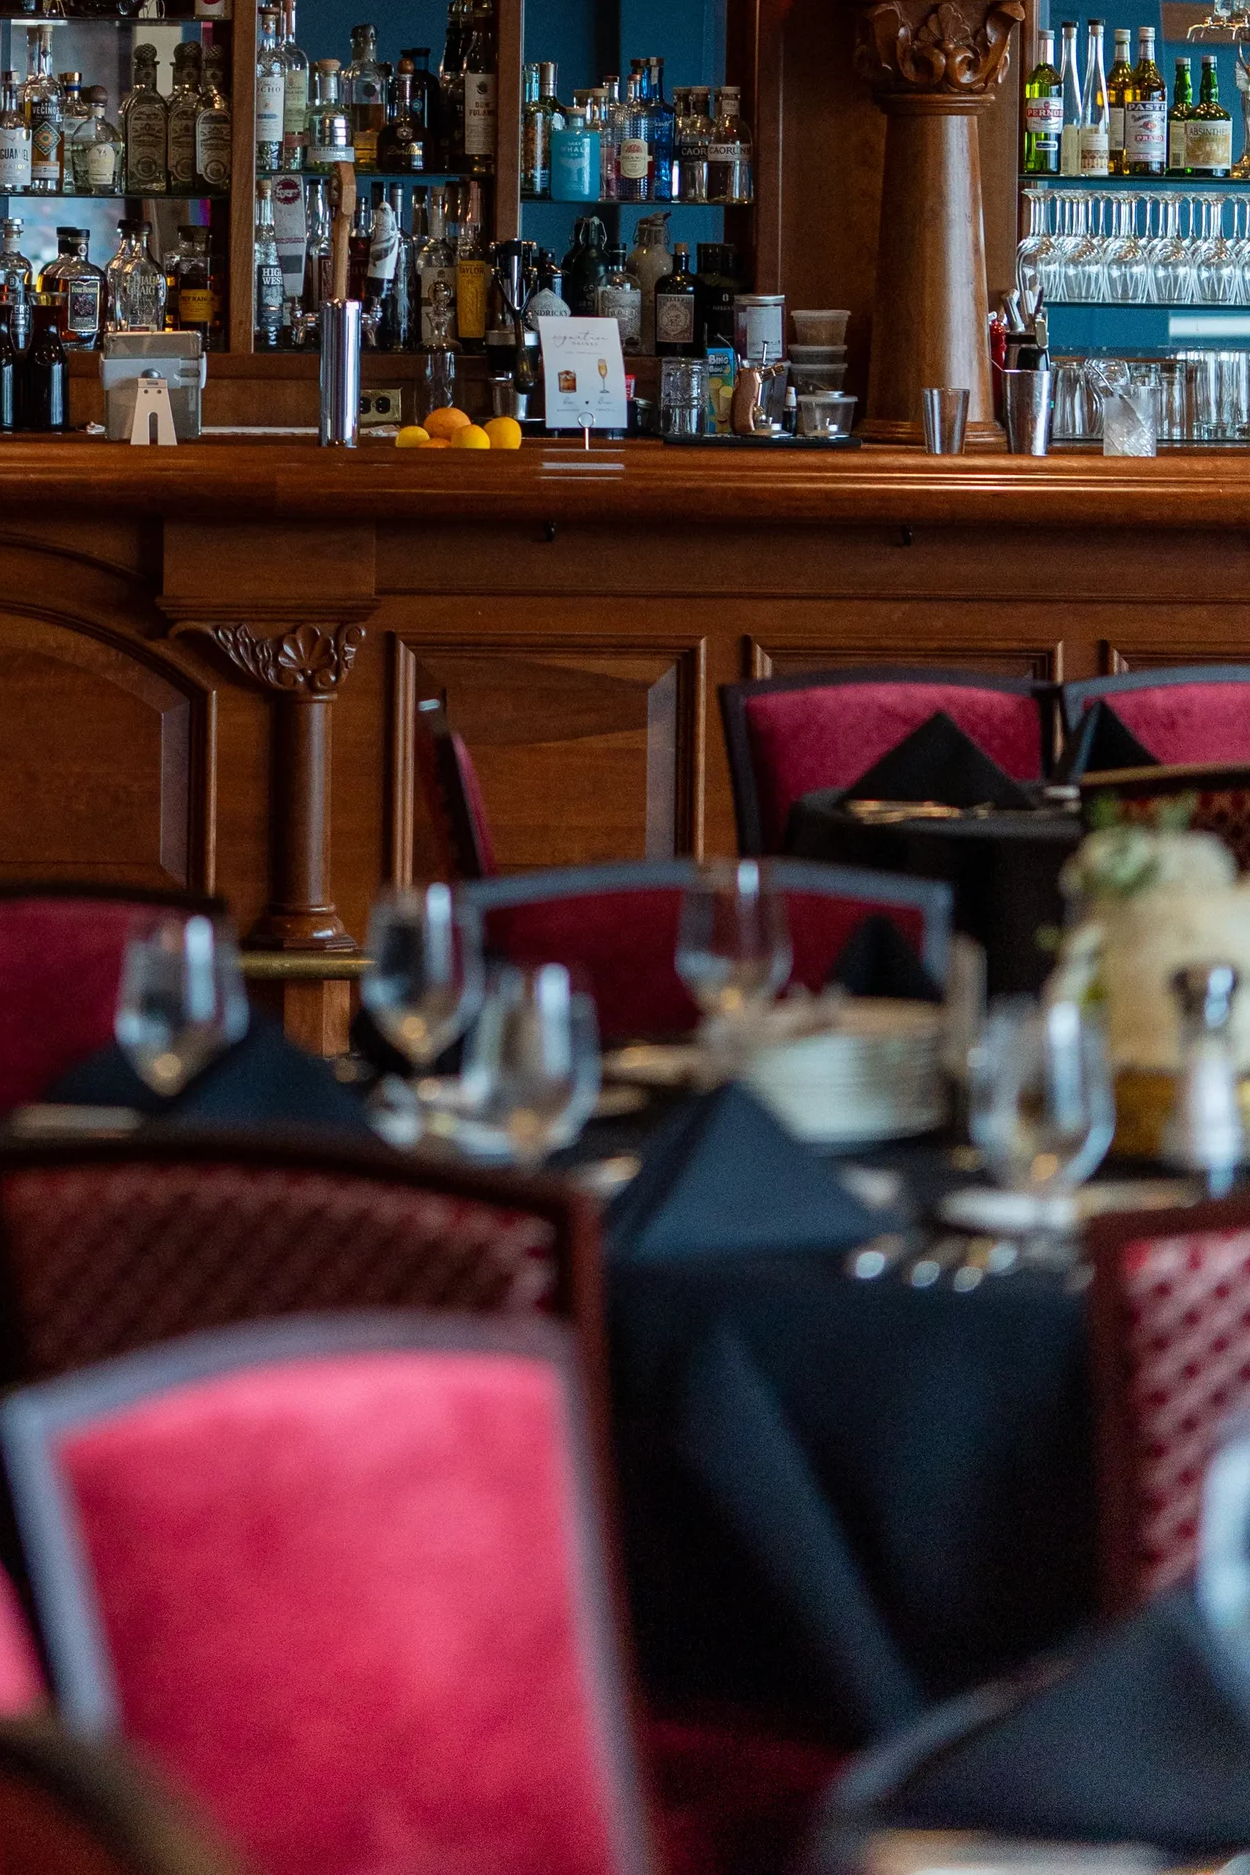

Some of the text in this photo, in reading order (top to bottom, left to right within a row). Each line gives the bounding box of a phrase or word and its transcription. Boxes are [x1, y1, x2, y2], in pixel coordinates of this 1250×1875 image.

[32, 106, 60, 115] VECINOS
[681, 147, 708, 156] CAOR
[459, 266, 485, 275] TAYLOR
[708, 355, 729, 365] BING
